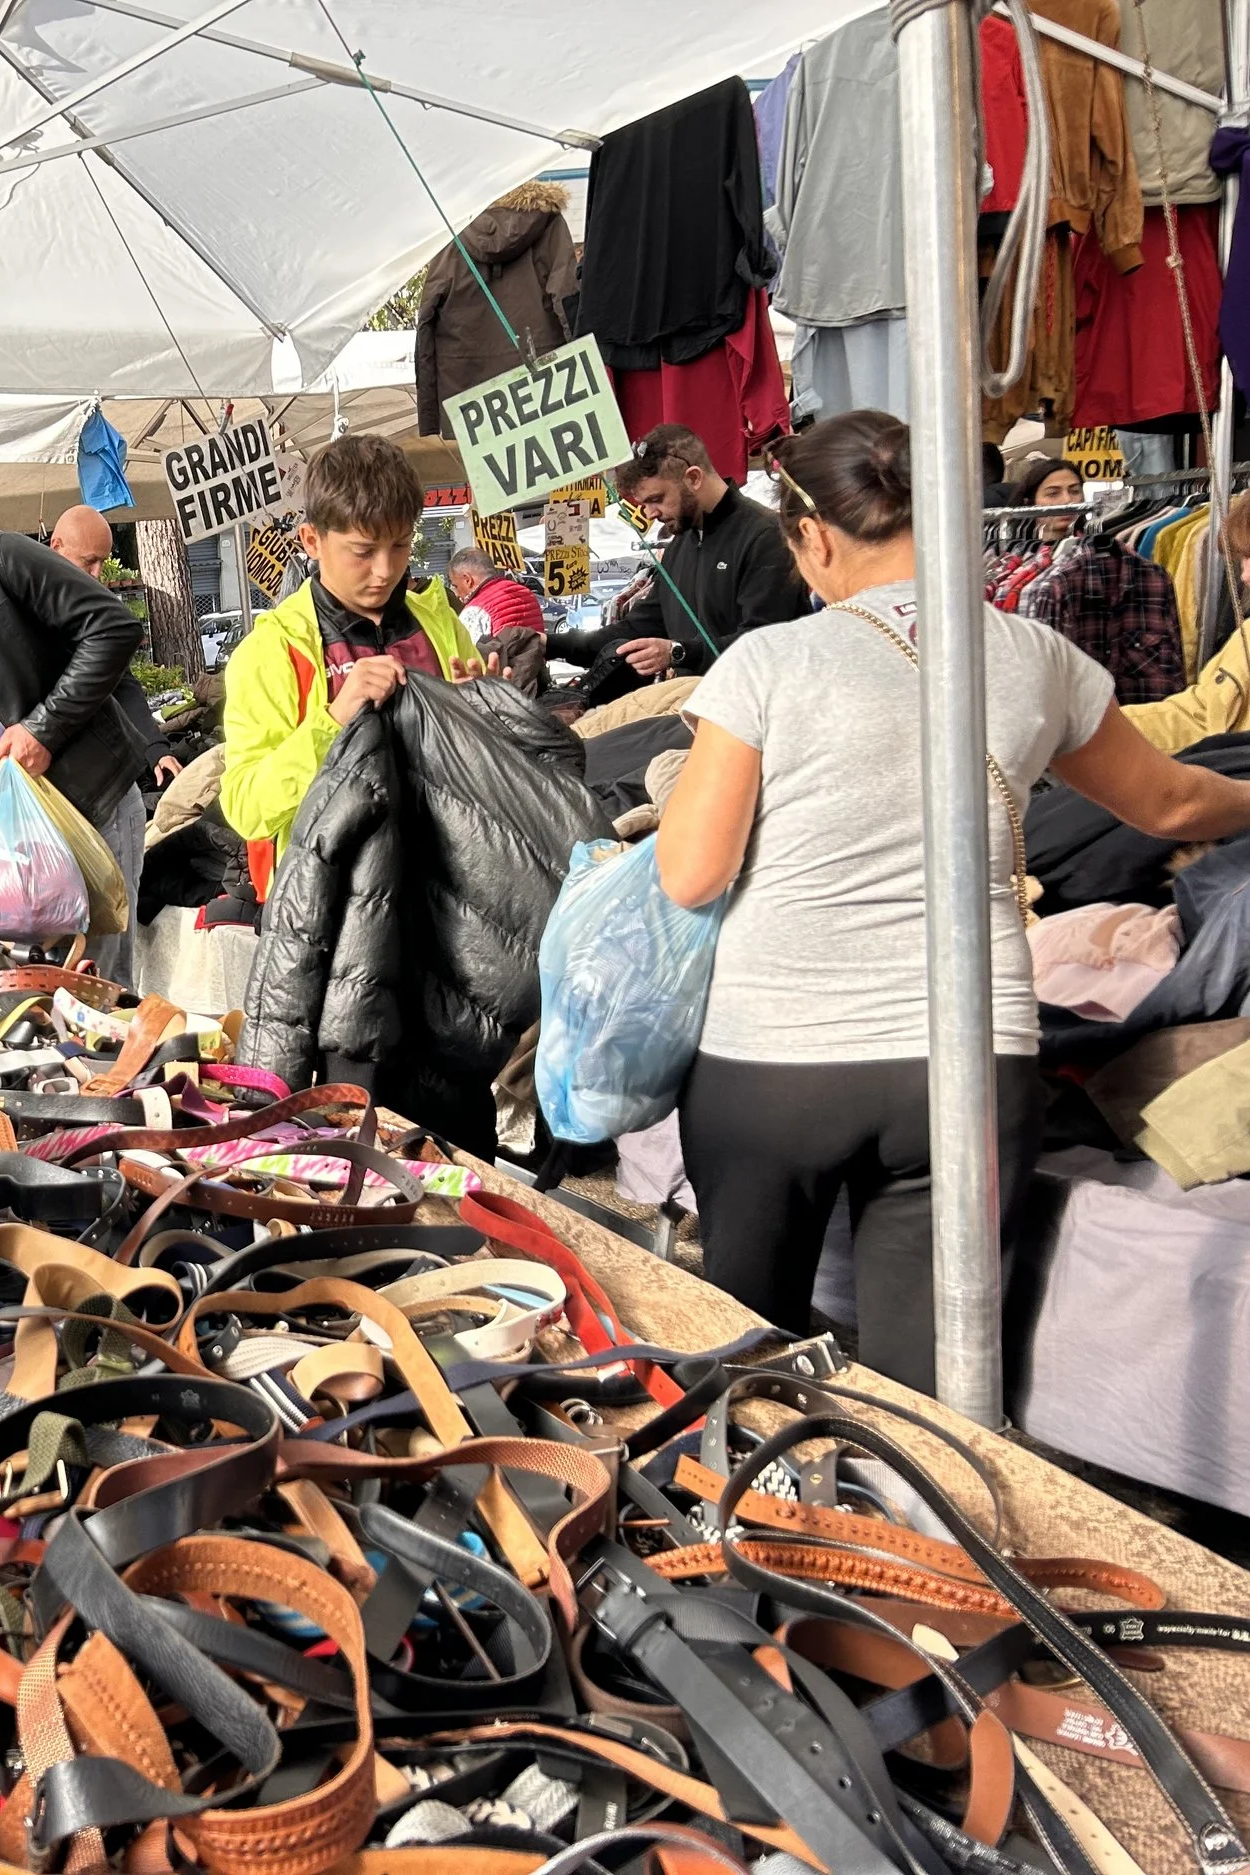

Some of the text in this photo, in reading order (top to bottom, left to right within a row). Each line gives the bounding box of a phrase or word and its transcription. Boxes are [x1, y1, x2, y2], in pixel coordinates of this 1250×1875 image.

[459, 350, 601, 446] PREZZI
[165, 418, 271, 492] GRANDI
[482, 410, 609, 497] VARI
[176, 461, 282, 539] FIRME
[471, 509, 517, 542] PREZZI
[548, 560, 565, 596] 5
